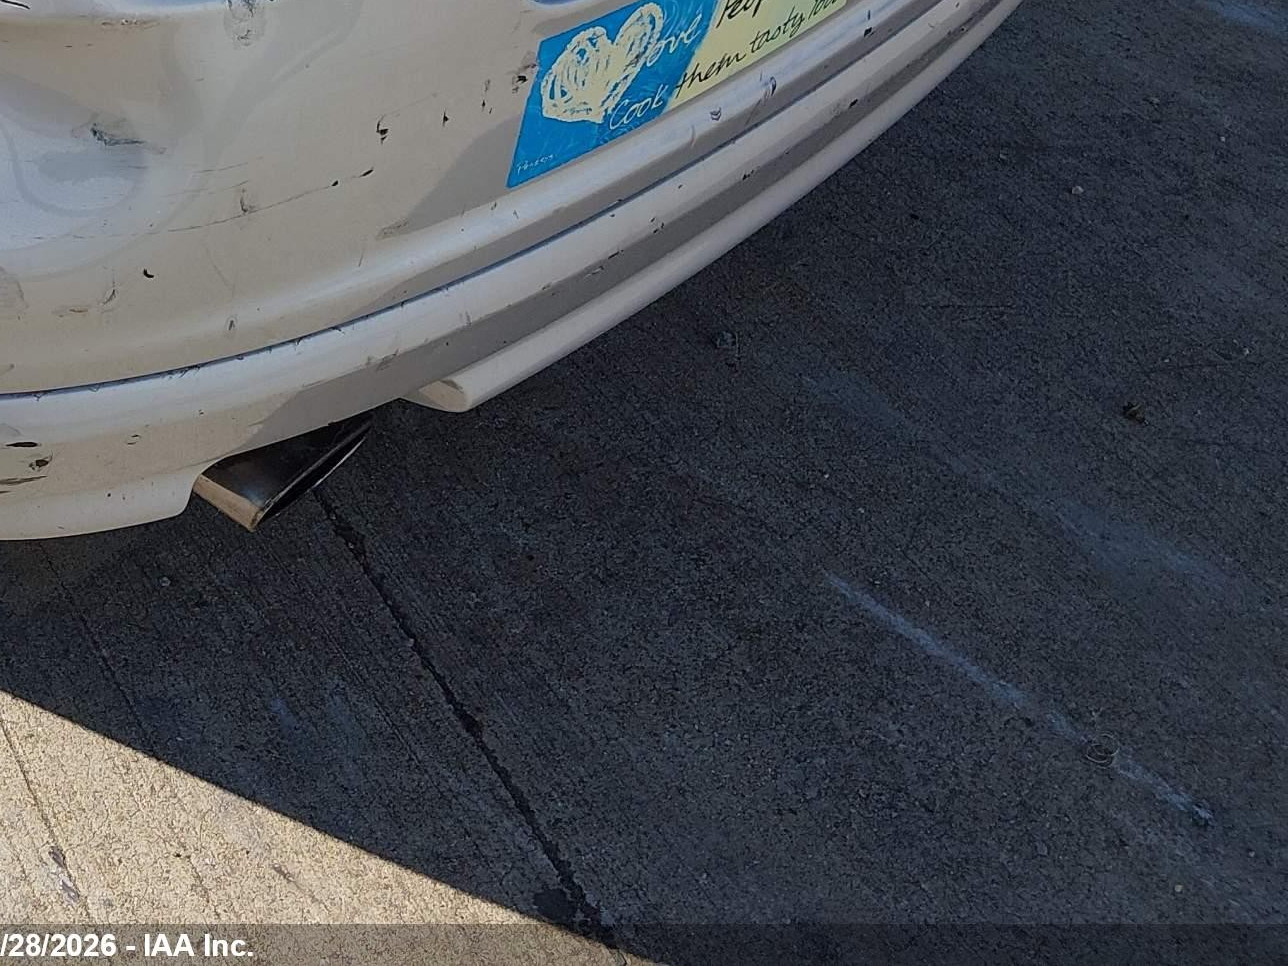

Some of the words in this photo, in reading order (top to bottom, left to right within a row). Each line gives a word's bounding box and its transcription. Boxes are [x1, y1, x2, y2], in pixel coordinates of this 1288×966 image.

[609, 83, 669, 130] Cook
[675, 51, 747, 99] them
[749, 5, 806, 54] tasty
